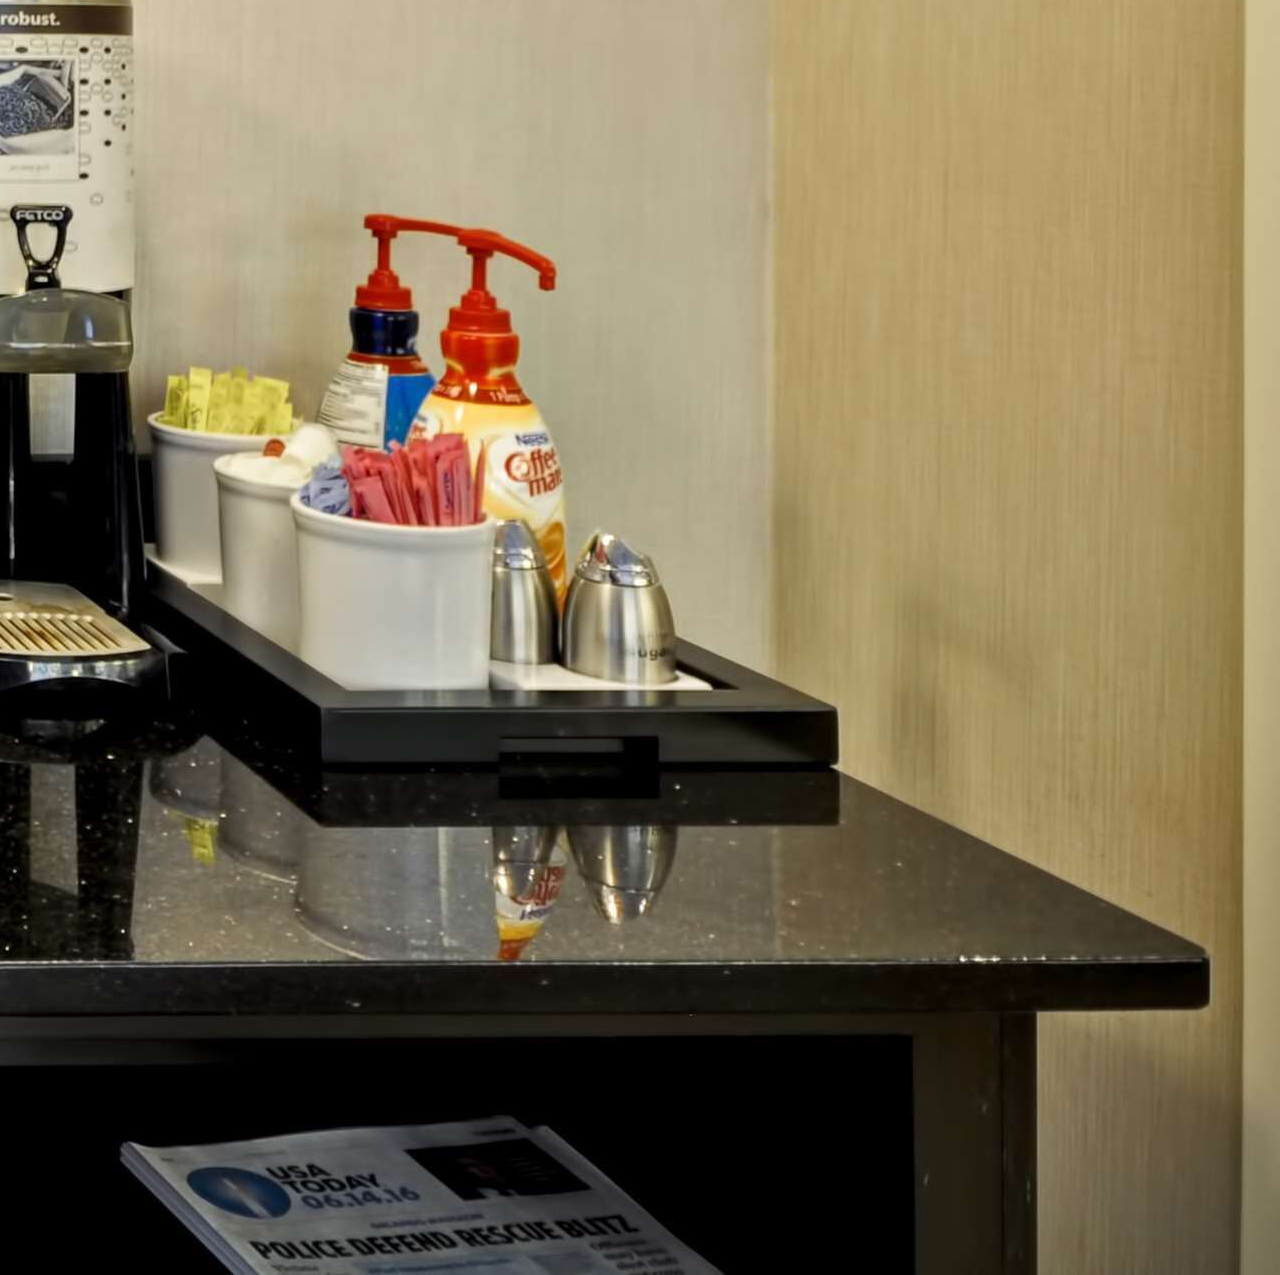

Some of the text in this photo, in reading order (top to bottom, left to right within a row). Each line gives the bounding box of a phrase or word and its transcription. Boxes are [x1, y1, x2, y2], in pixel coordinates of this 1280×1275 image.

[0, 10, 61, 26] robust.
[15, 209, 65, 222] FETCO
[529, 467, 562, 496] mat
[266, 1163, 331, 1180] USA
[282, 1173, 380, 1194] TODAY
[301, 1186, 420, 1209] 06.14.16
[249, 1214, 640, 1260] POLICE DEFEND RESCUE BLITZ
